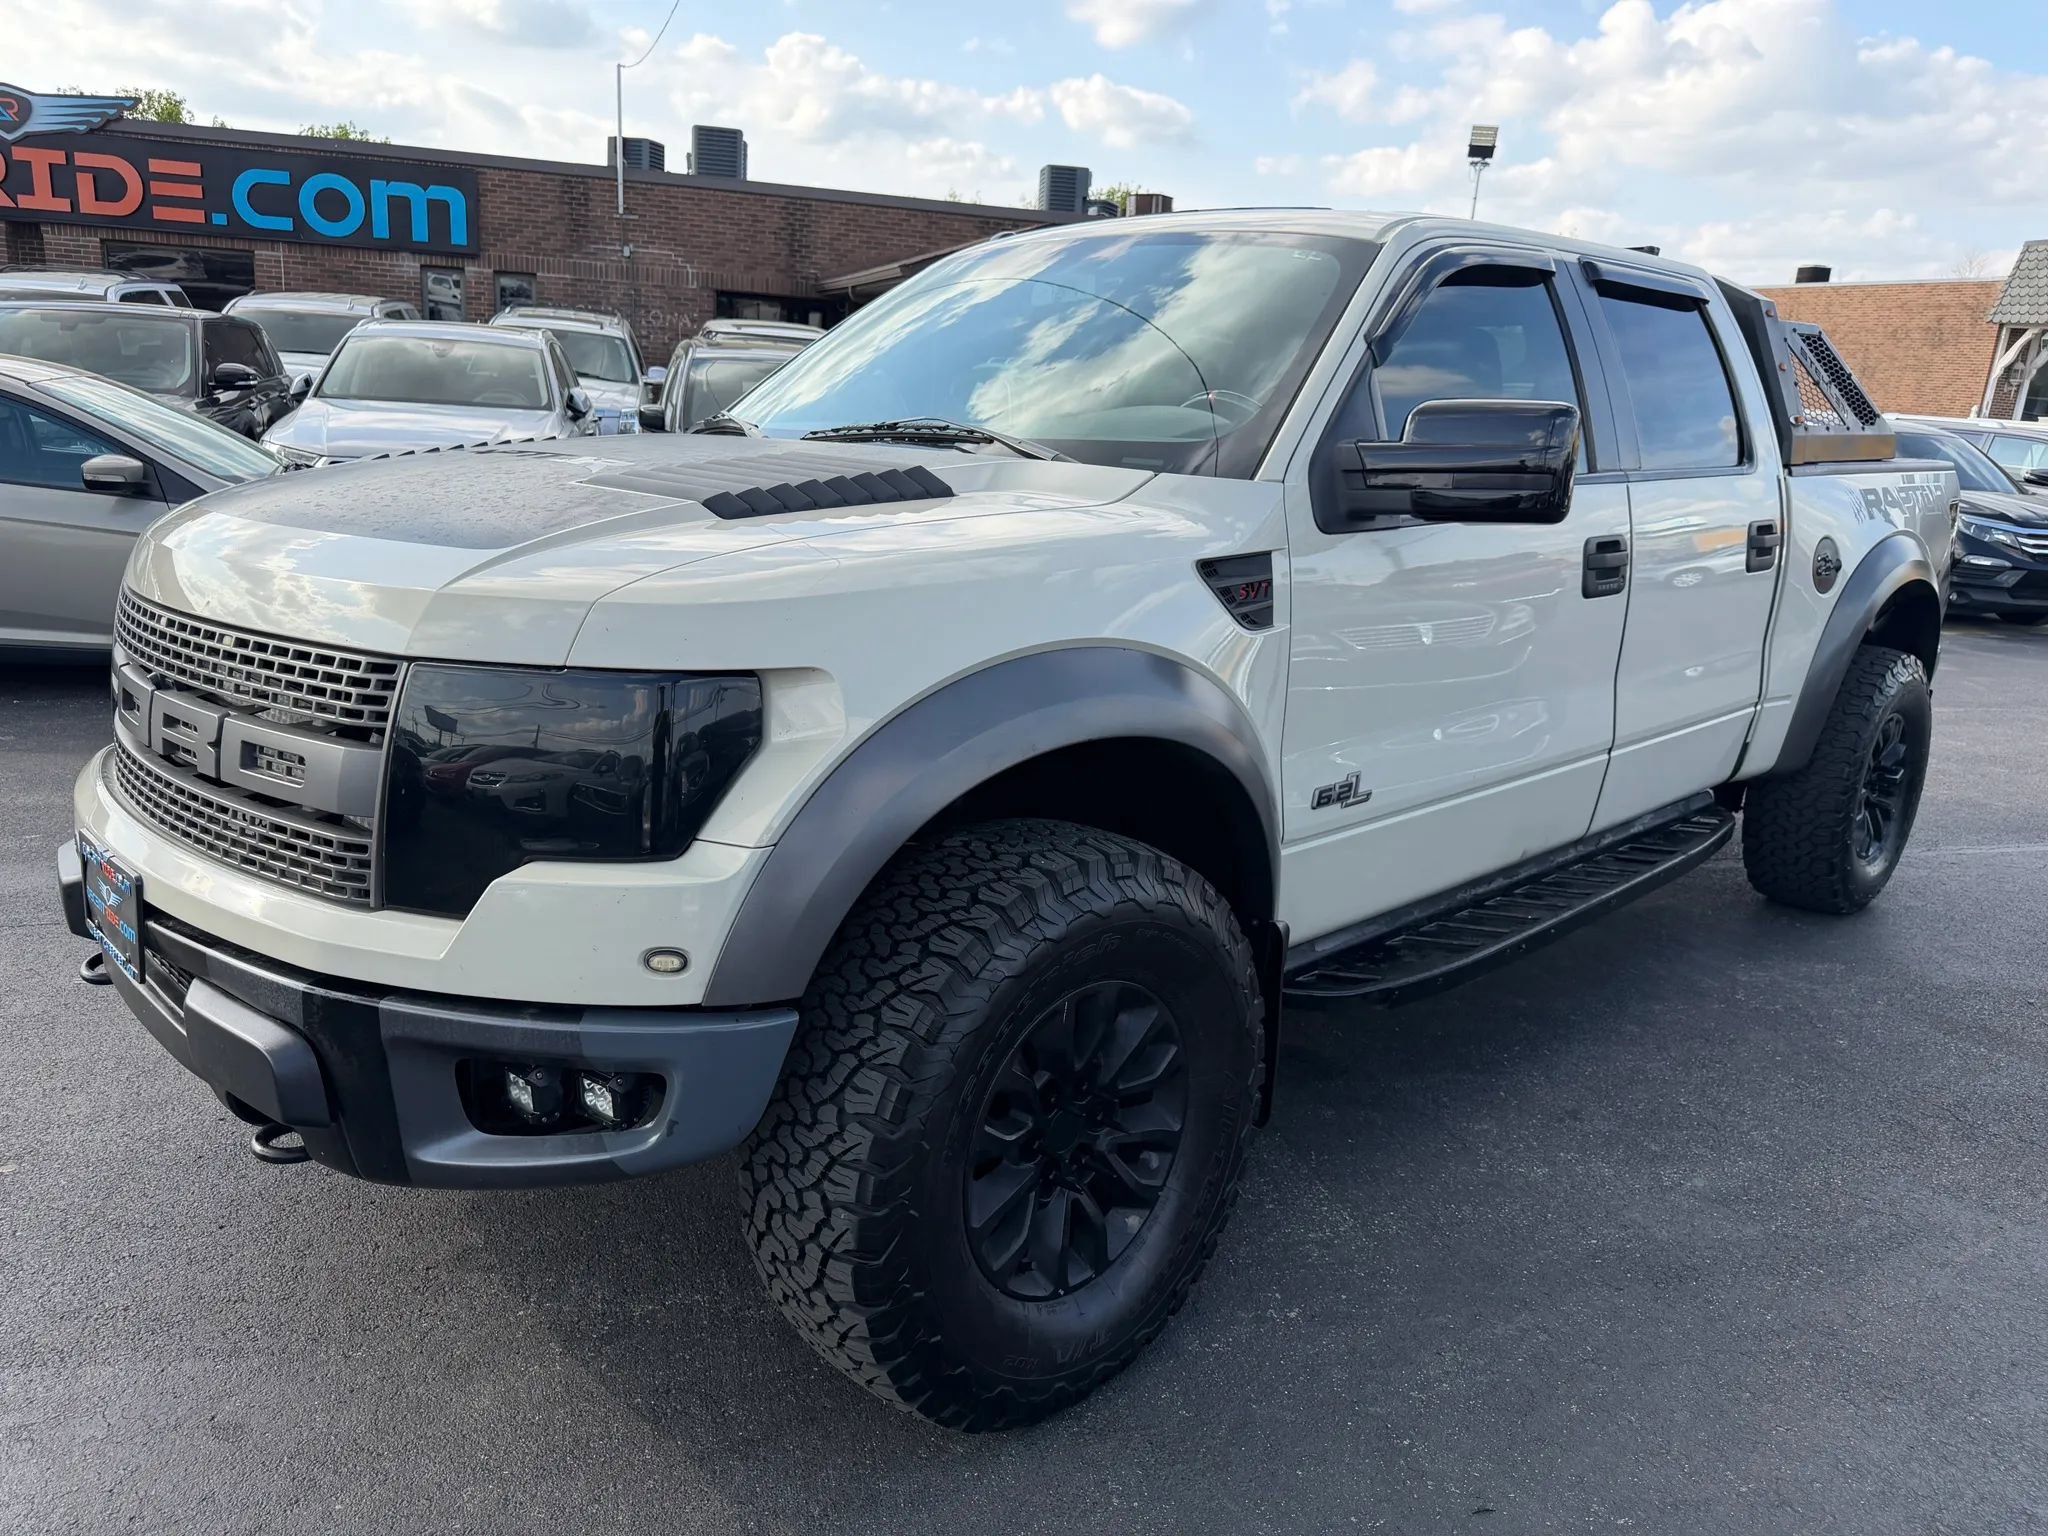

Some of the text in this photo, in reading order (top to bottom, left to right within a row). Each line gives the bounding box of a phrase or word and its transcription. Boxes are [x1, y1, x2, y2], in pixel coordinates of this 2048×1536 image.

[1859, 483, 1947, 519] RAPTOR
[1239, 580, 1270, 600] SVT
[112, 663, 345, 820] ORD
